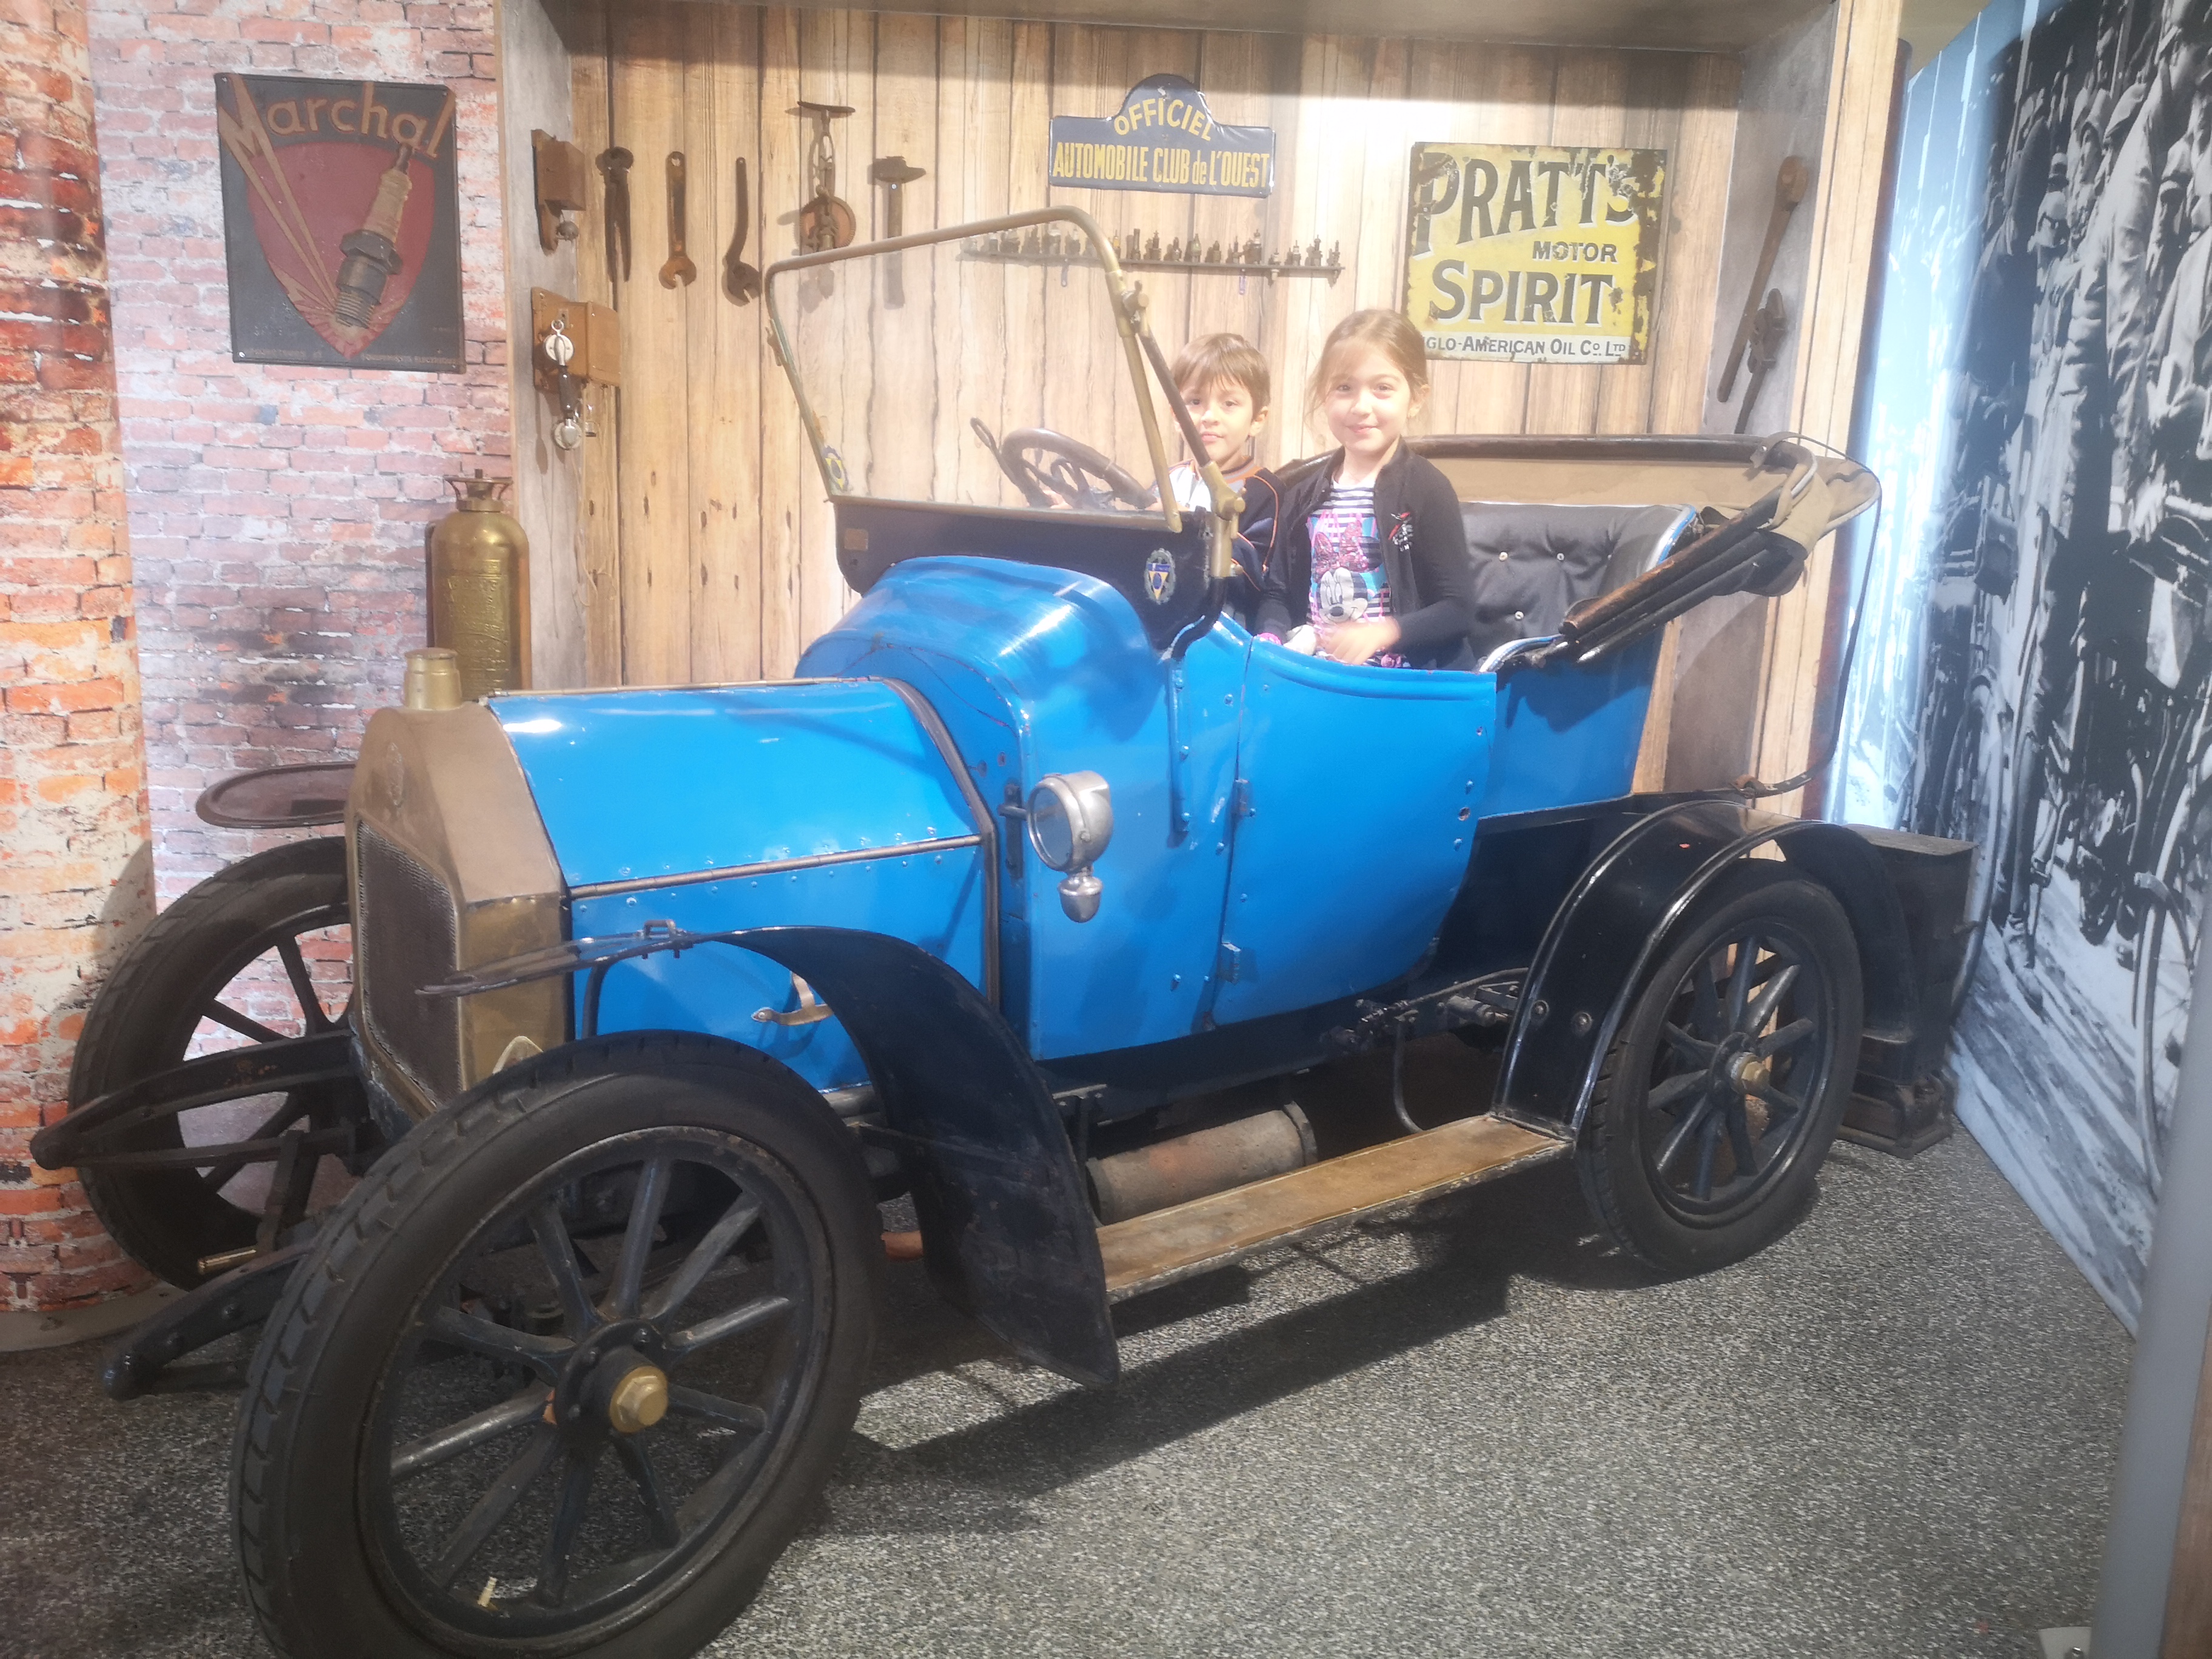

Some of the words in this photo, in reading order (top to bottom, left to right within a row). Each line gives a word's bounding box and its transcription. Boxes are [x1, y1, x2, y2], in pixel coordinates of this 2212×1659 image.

[217, 75, 456, 160] Marchal
[1114, 98, 1212, 141] OFFICIEL
[1053, 142, 1148, 182] AUTOMOBILE
[1153, 147, 1190, 184] CLUB
[1192, 150, 1207, 184] de
[1209, 150, 1270, 188] L'OUEST
[1533, 241, 1618, 263] MOTOR
[1430, 259, 1614, 324] SPIRIT
[1425, 335, 1546, 356] GLO-AMERICAN
[1550, 338, 1575, 355] OIL
